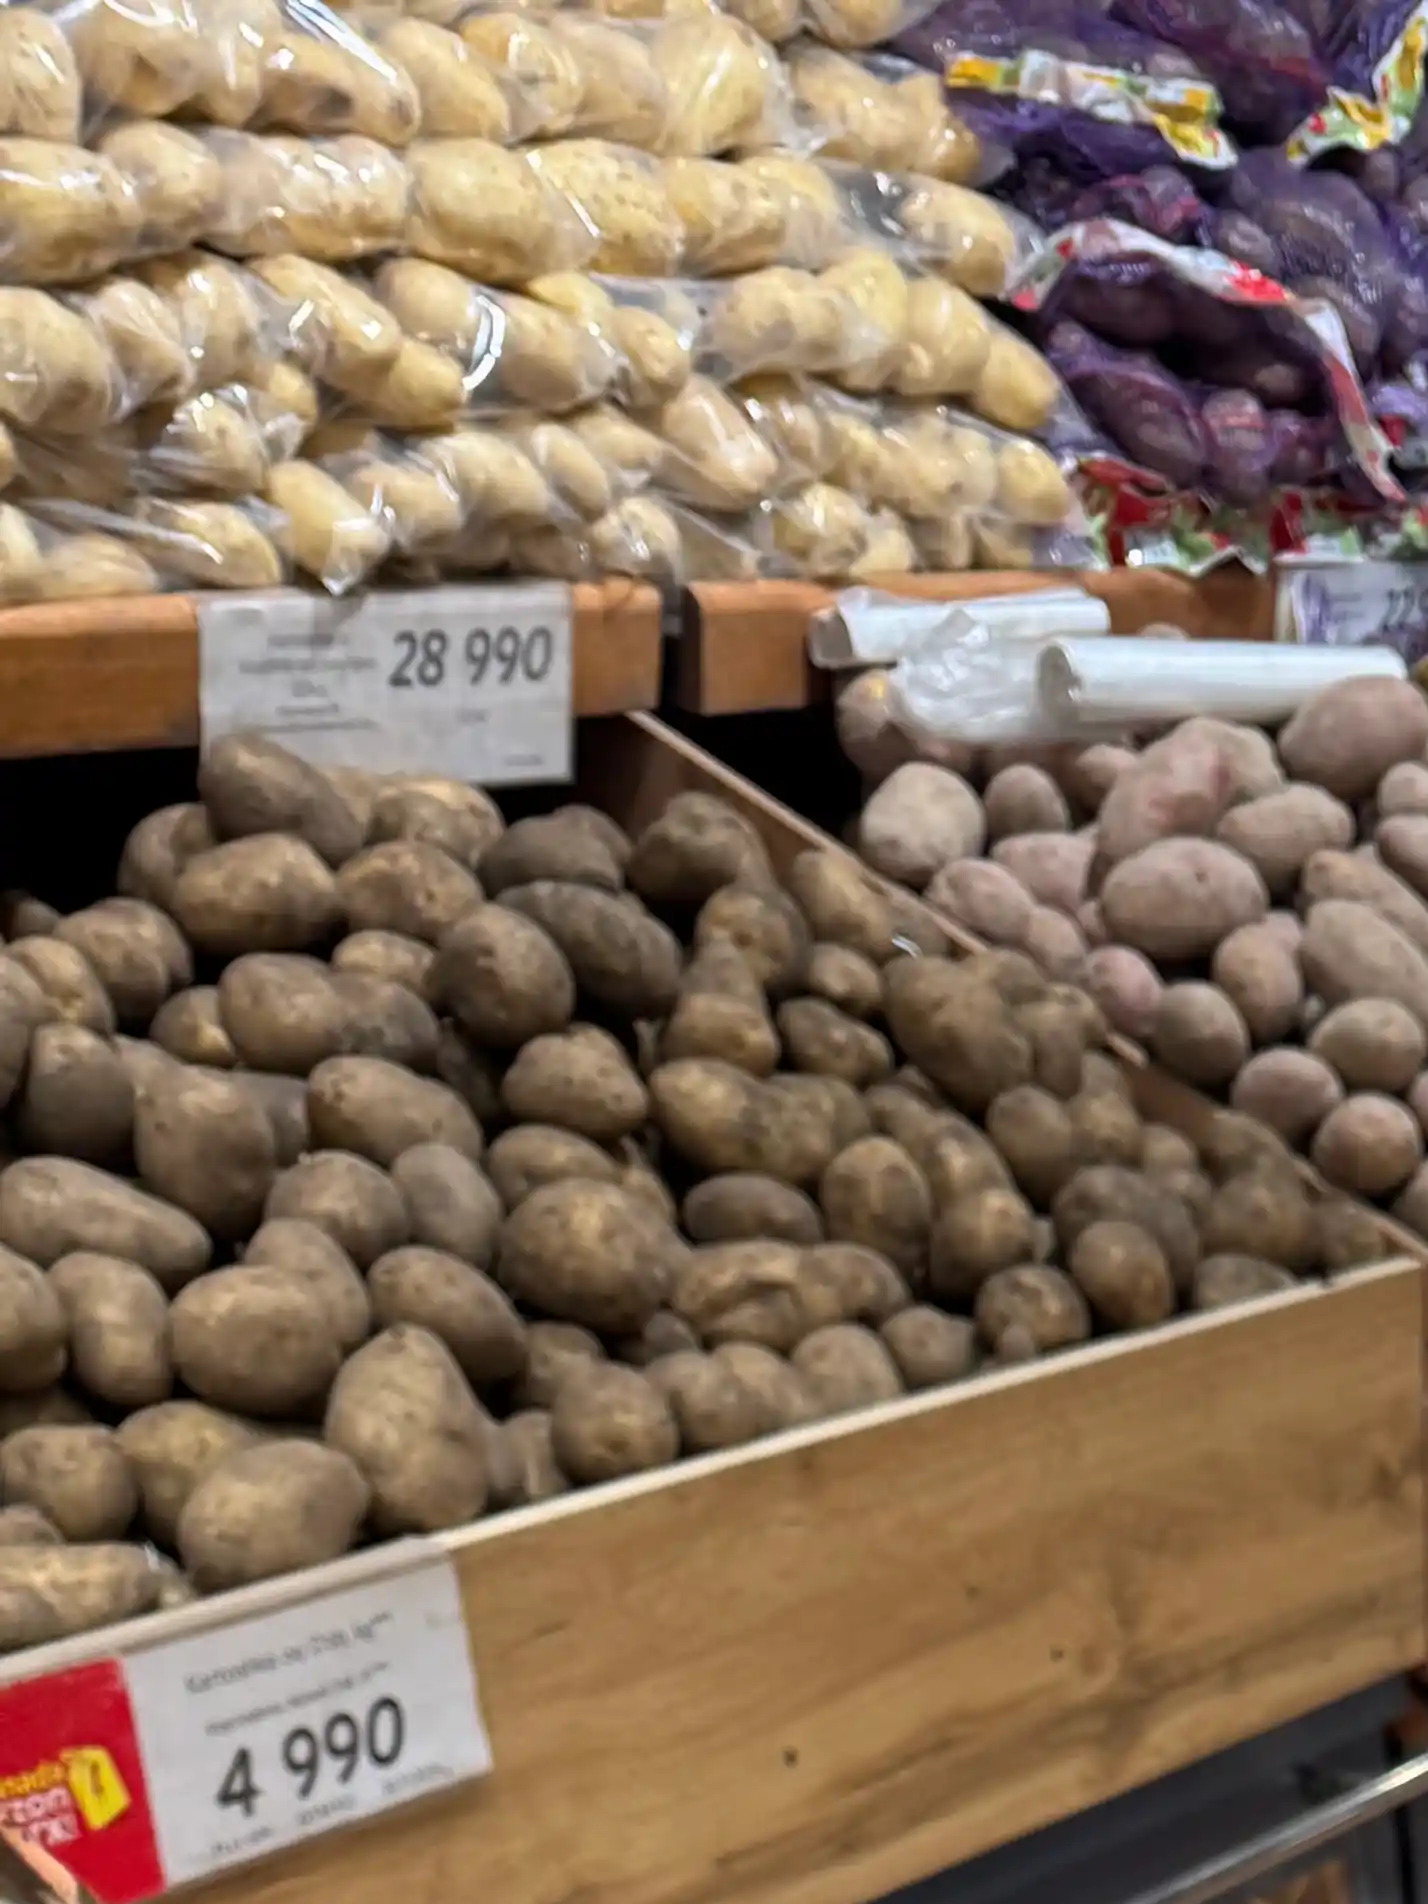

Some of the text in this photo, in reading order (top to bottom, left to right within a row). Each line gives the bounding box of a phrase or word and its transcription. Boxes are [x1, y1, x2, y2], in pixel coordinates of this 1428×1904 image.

[387, 627, 448, 687] 28
[464, 625, 554, 686] 990
[215, 1747, 260, 1816] 4
[282, 1695, 406, 1798] 990
